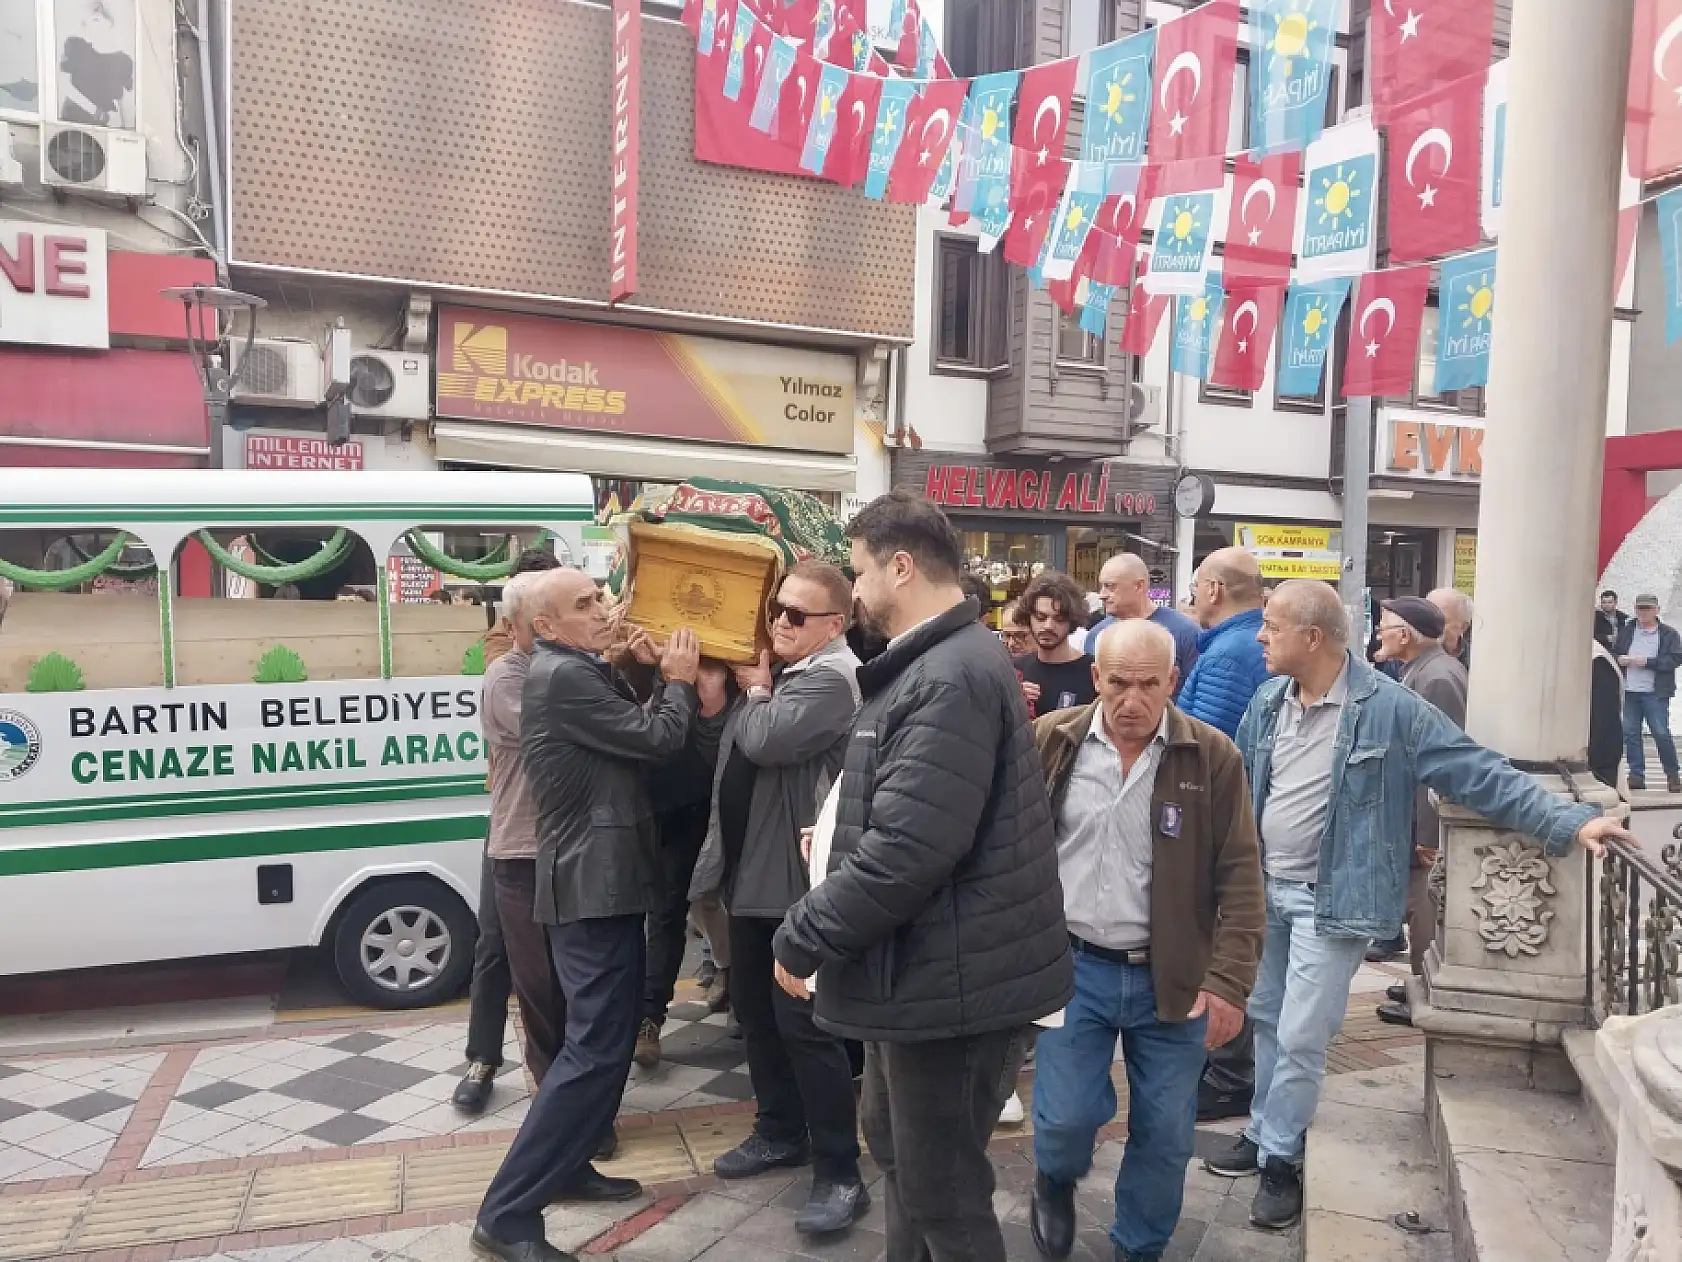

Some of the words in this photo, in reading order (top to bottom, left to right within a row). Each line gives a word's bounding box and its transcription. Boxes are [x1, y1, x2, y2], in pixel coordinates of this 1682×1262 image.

[612, 9, 630, 283] INTERNET
[513, 353, 599, 385] Kodak
[780, 376, 843, 398] Yılmaz
[474, 376, 627, 415] EXPRESS
[784, 402, 836, 423] Color
[247, 450, 362, 470] INTERNET
[1392, 421, 1484, 473] EVK
[925, 464, 1052, 510] HELVACI
[1055, 459, 1110, 512] ALİ
[70, 701, 228, 738] BARTIN
[71, 744, 235, 785] CENAZE
